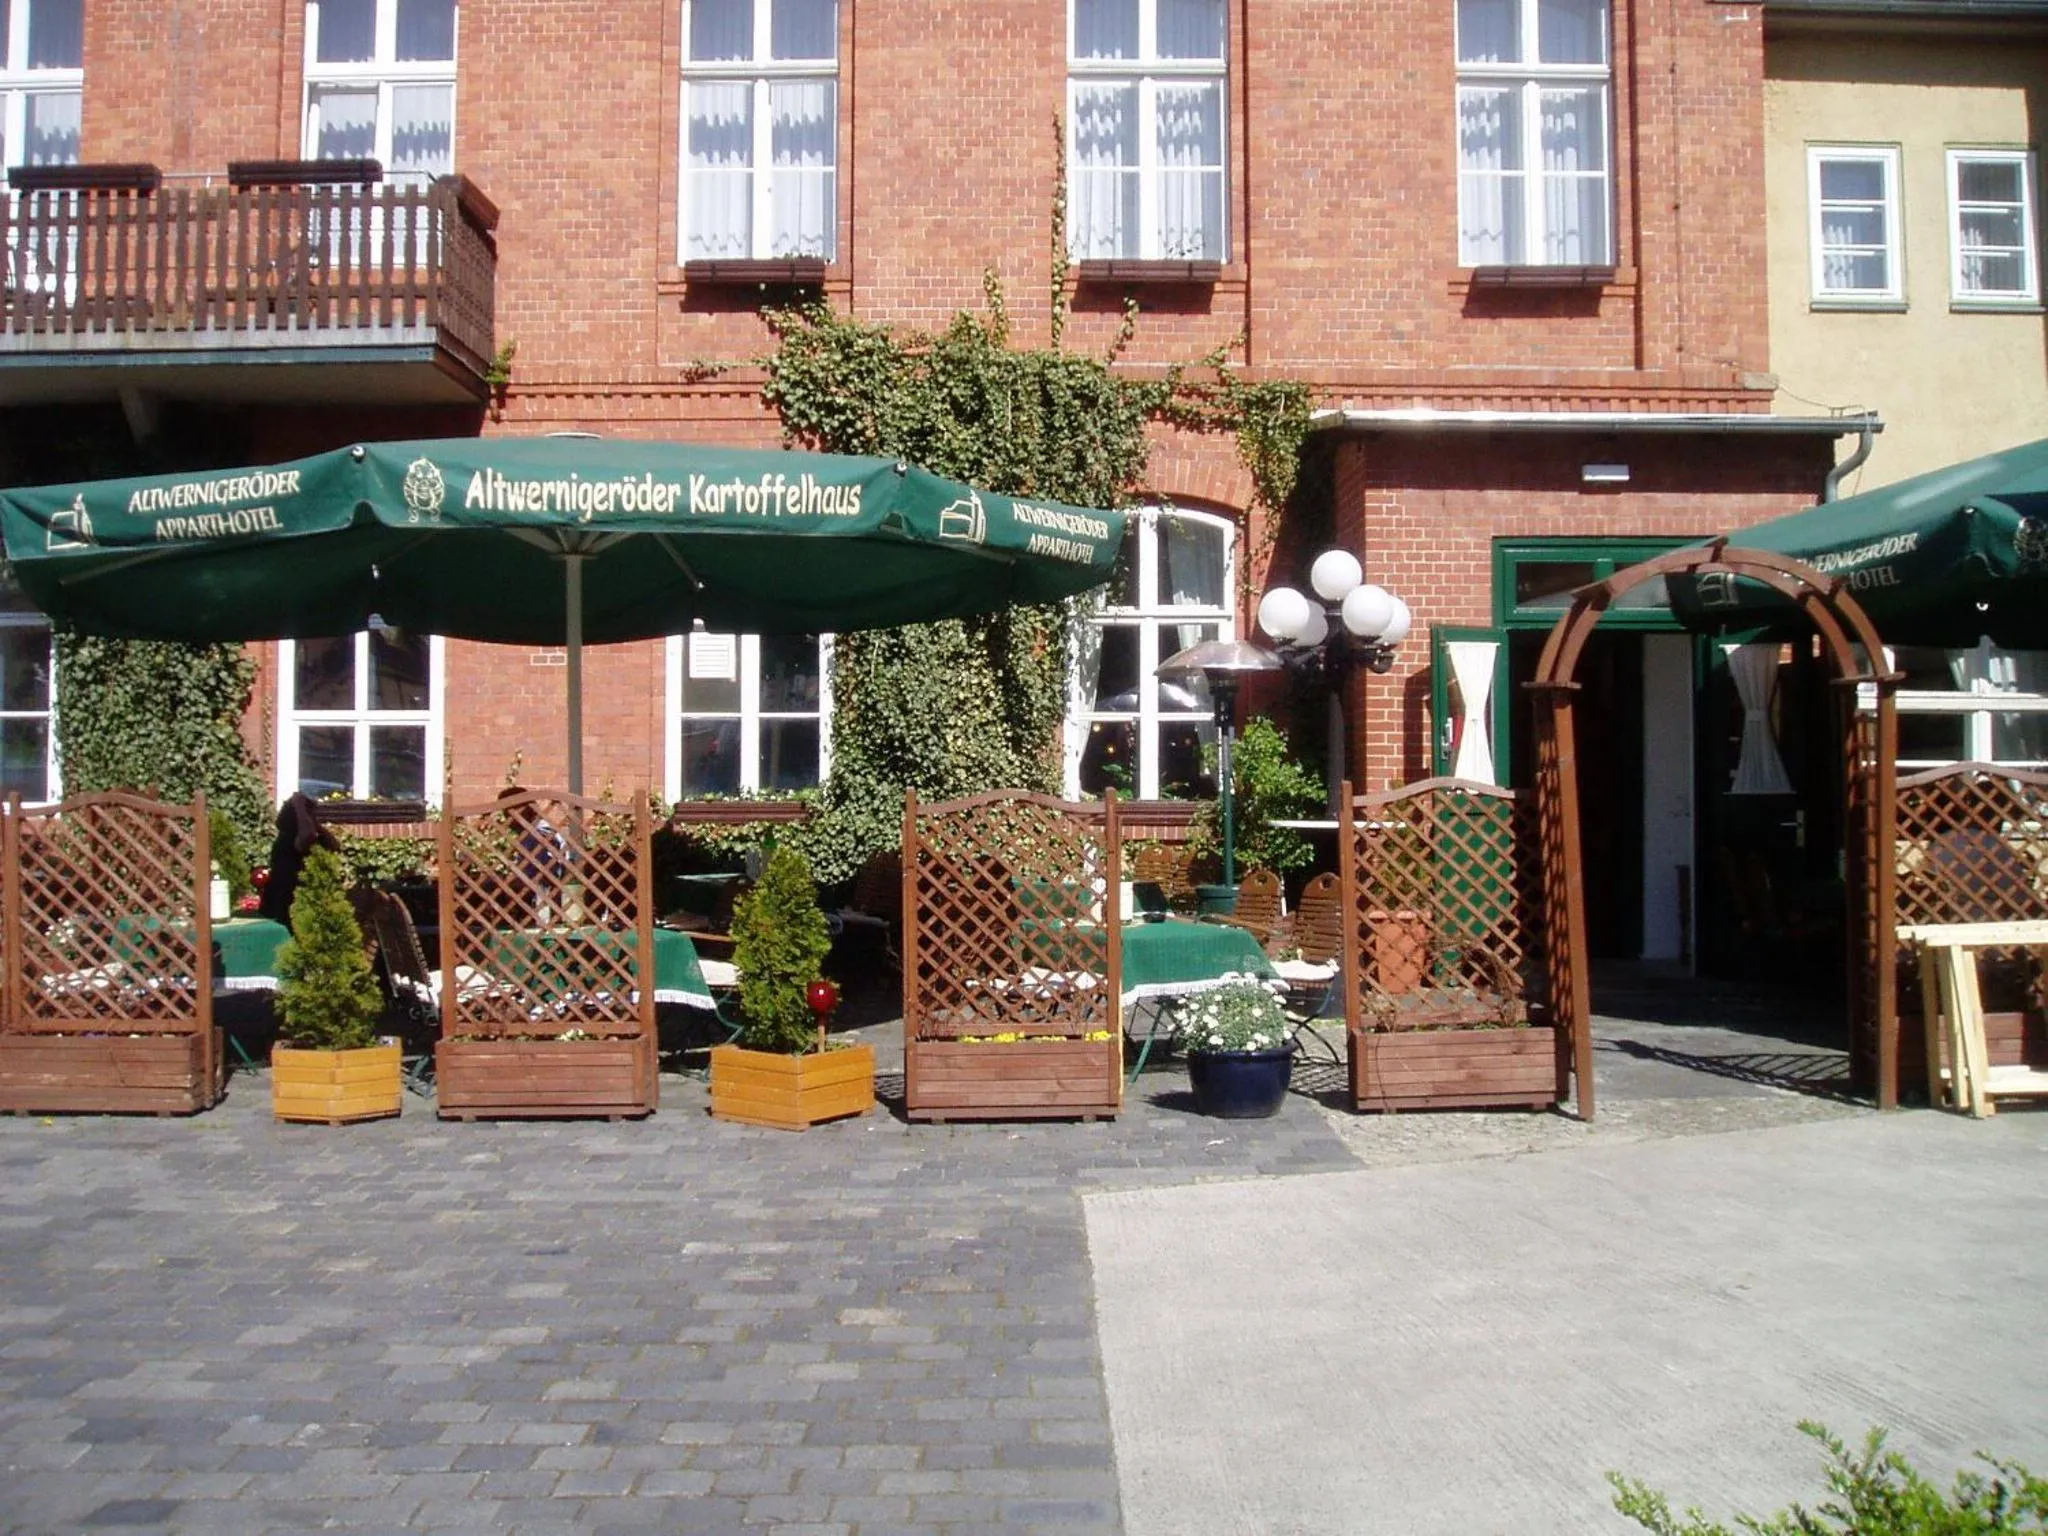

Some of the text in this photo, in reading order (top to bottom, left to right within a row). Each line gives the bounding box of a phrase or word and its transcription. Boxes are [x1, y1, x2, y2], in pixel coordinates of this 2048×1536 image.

[128, 470, 300, 513] ALTWERNIGERÖDER
[465, 466, 861, 522] Altwernigeröder Kartoffelhaus
[156, 506, 284, 542] APPARTHOTEL
[1026, 533, 1094, 564] APPARTHOTEL
